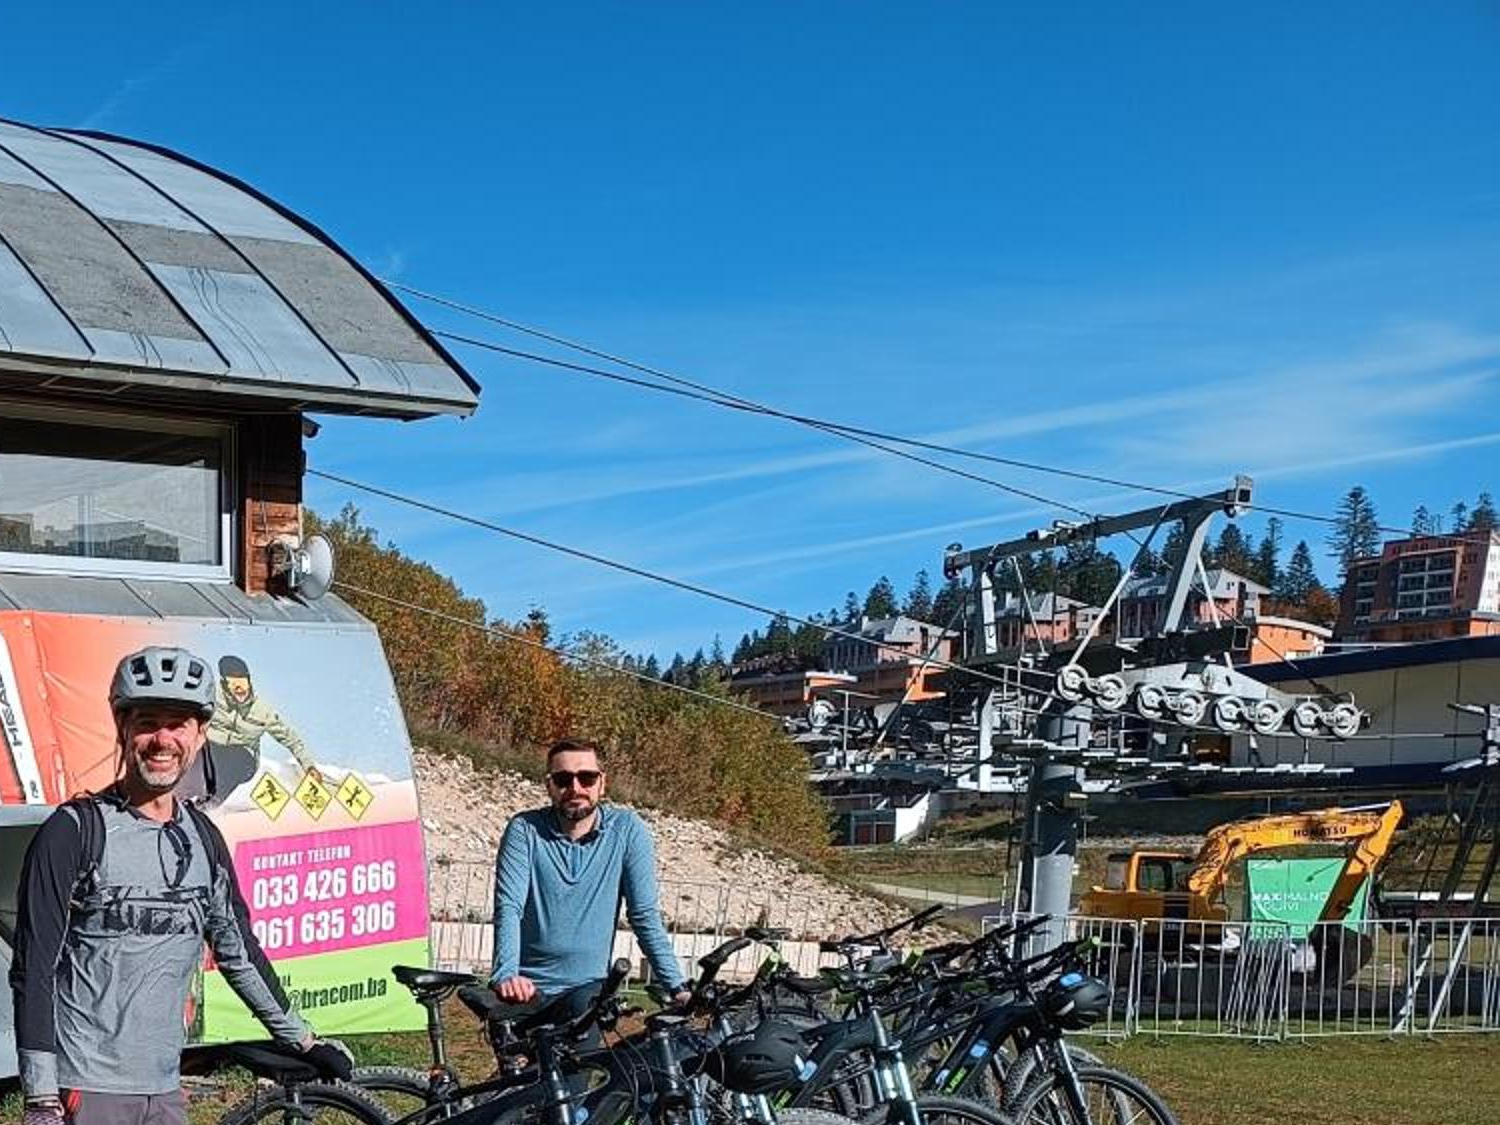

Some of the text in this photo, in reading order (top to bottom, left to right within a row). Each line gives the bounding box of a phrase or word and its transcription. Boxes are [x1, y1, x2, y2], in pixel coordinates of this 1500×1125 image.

[253, 845, 352, 871] KONTAKT TELEFON
[253, 860, 396, 910] 033 426 666
[253, 901, 396, 949] 061 635 306
[287, 976, 387, 1010] @bracom.ba
